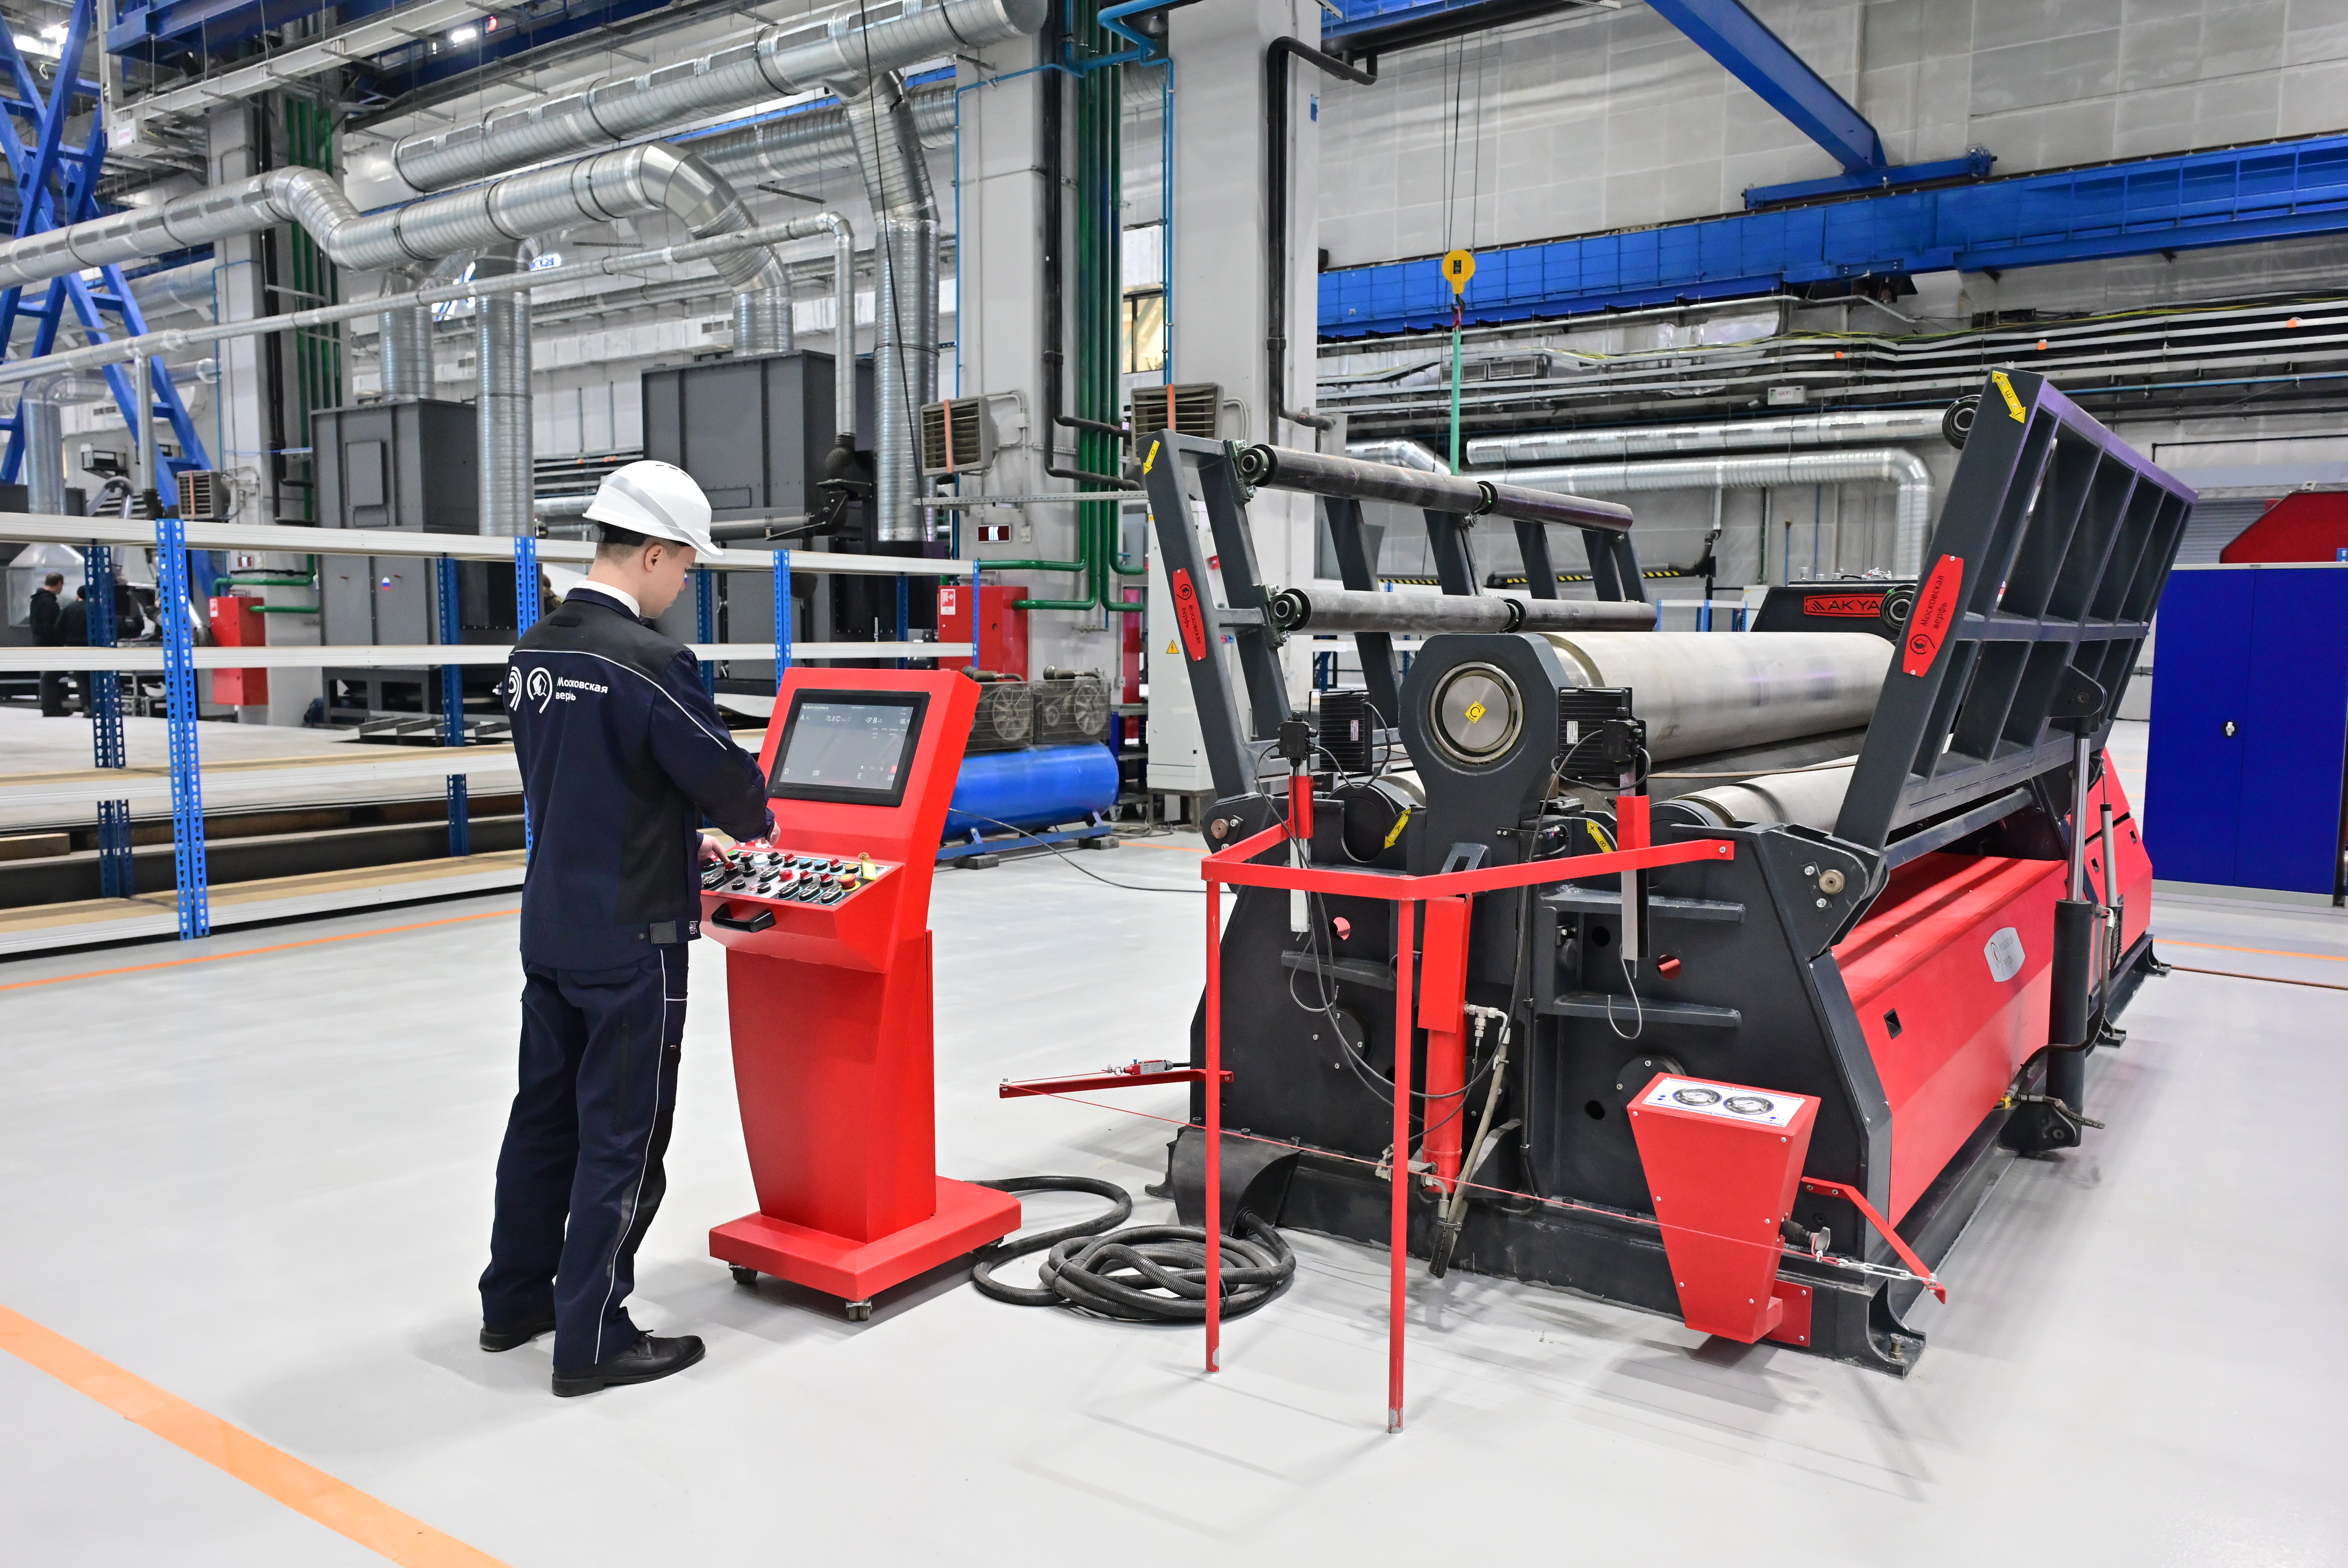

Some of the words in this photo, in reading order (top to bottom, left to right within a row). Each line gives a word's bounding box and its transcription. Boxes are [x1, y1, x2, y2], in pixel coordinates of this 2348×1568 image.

[988, 526, 999, 541] ПК
[1921, 575, 1944, 627] Московская
[1182, 607, 1190, 628] верфь
[1189, 605, 1201, 644] Московская
[1933, 602, 1948, 629] верфь
[556, 677, 608, 694] Московская
[1470, 707, 1480, 718] C
